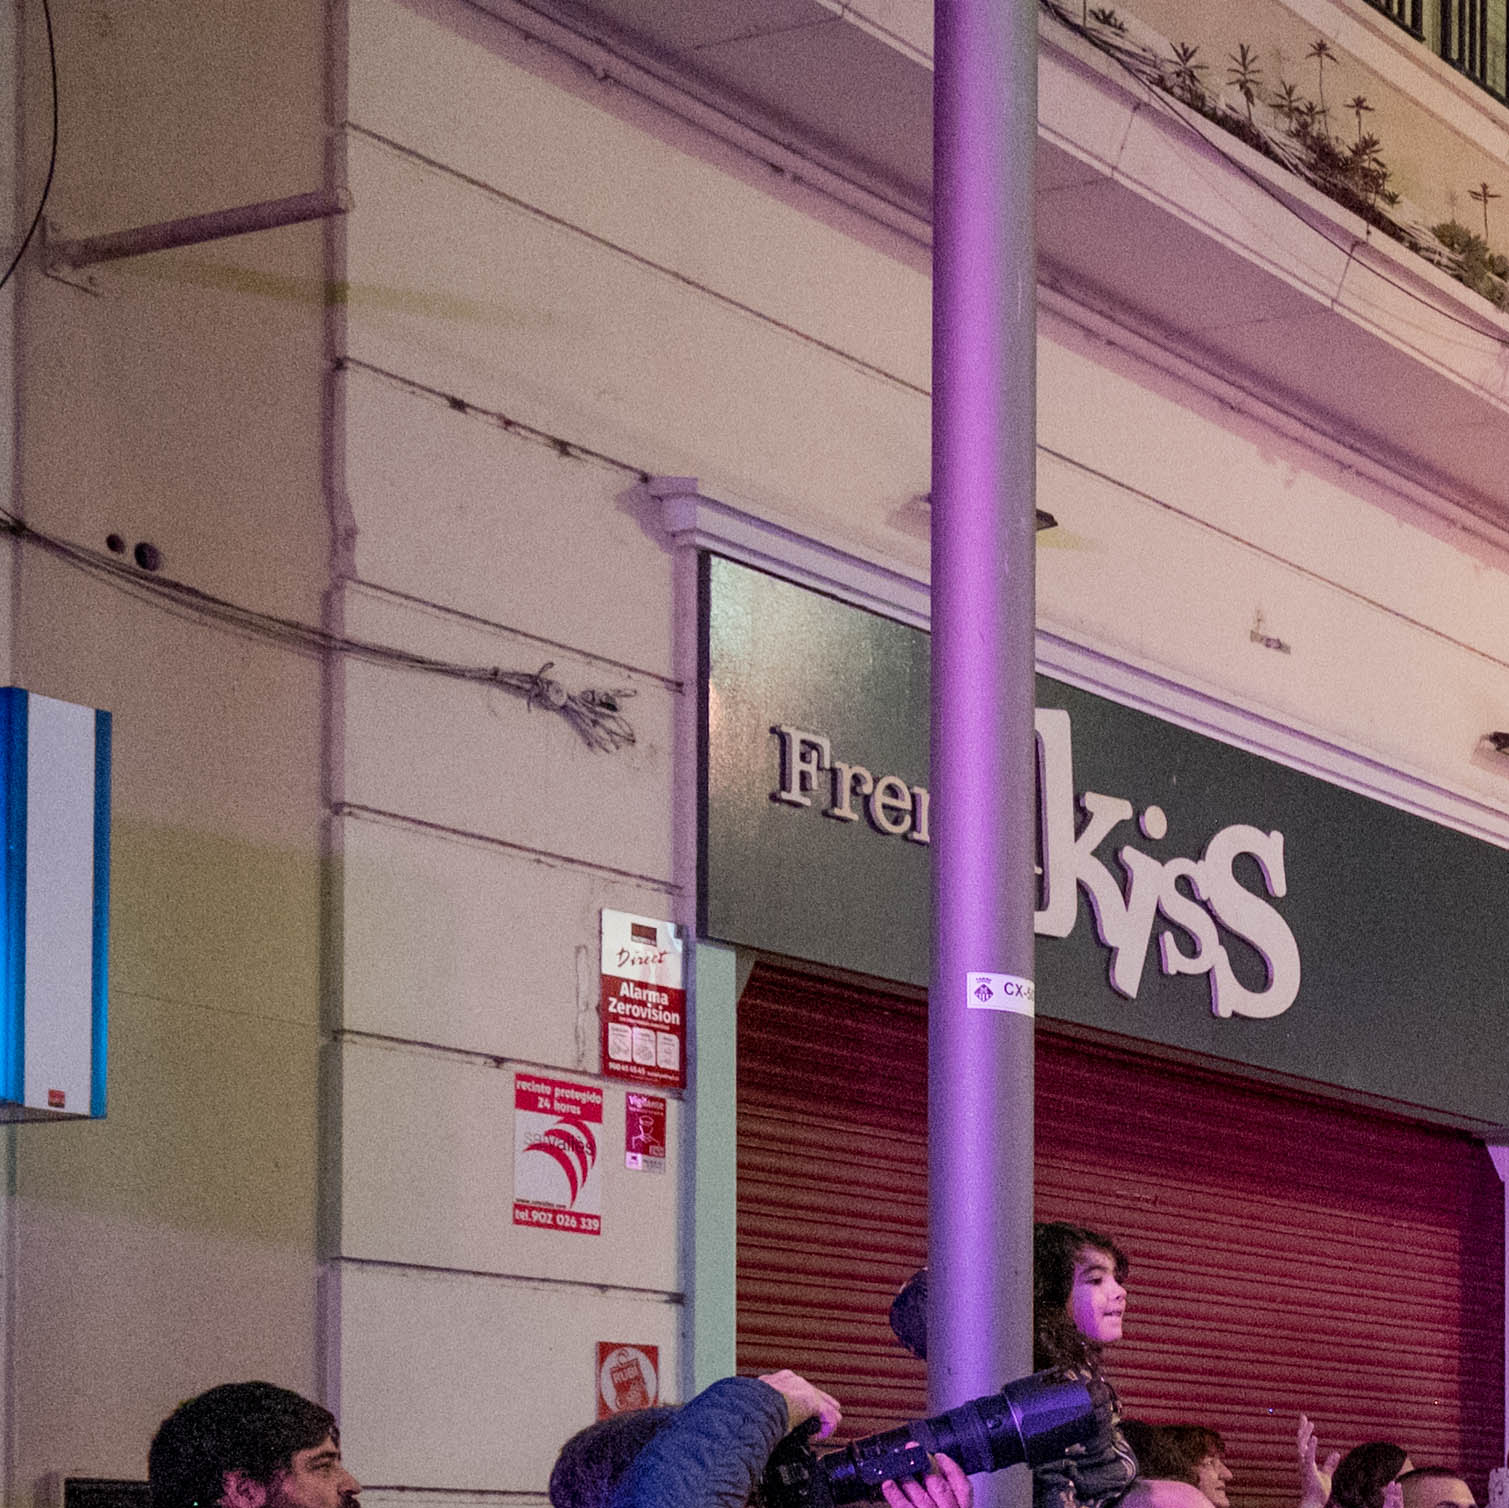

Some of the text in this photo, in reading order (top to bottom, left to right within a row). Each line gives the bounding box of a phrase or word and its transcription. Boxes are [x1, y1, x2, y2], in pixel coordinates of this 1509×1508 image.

[616, 947, 670, 968] Direct
[619, 982, 669, 1006] Alarma
[608, 997, 680, 1025] Zerovision
[516, 1080, 601, 1104] recinto protegido
[537, 1097, 581, 1115] 24 horas
[556, 1213, 577, 1228] 026
[580, 1217, 599, 1230] 339
